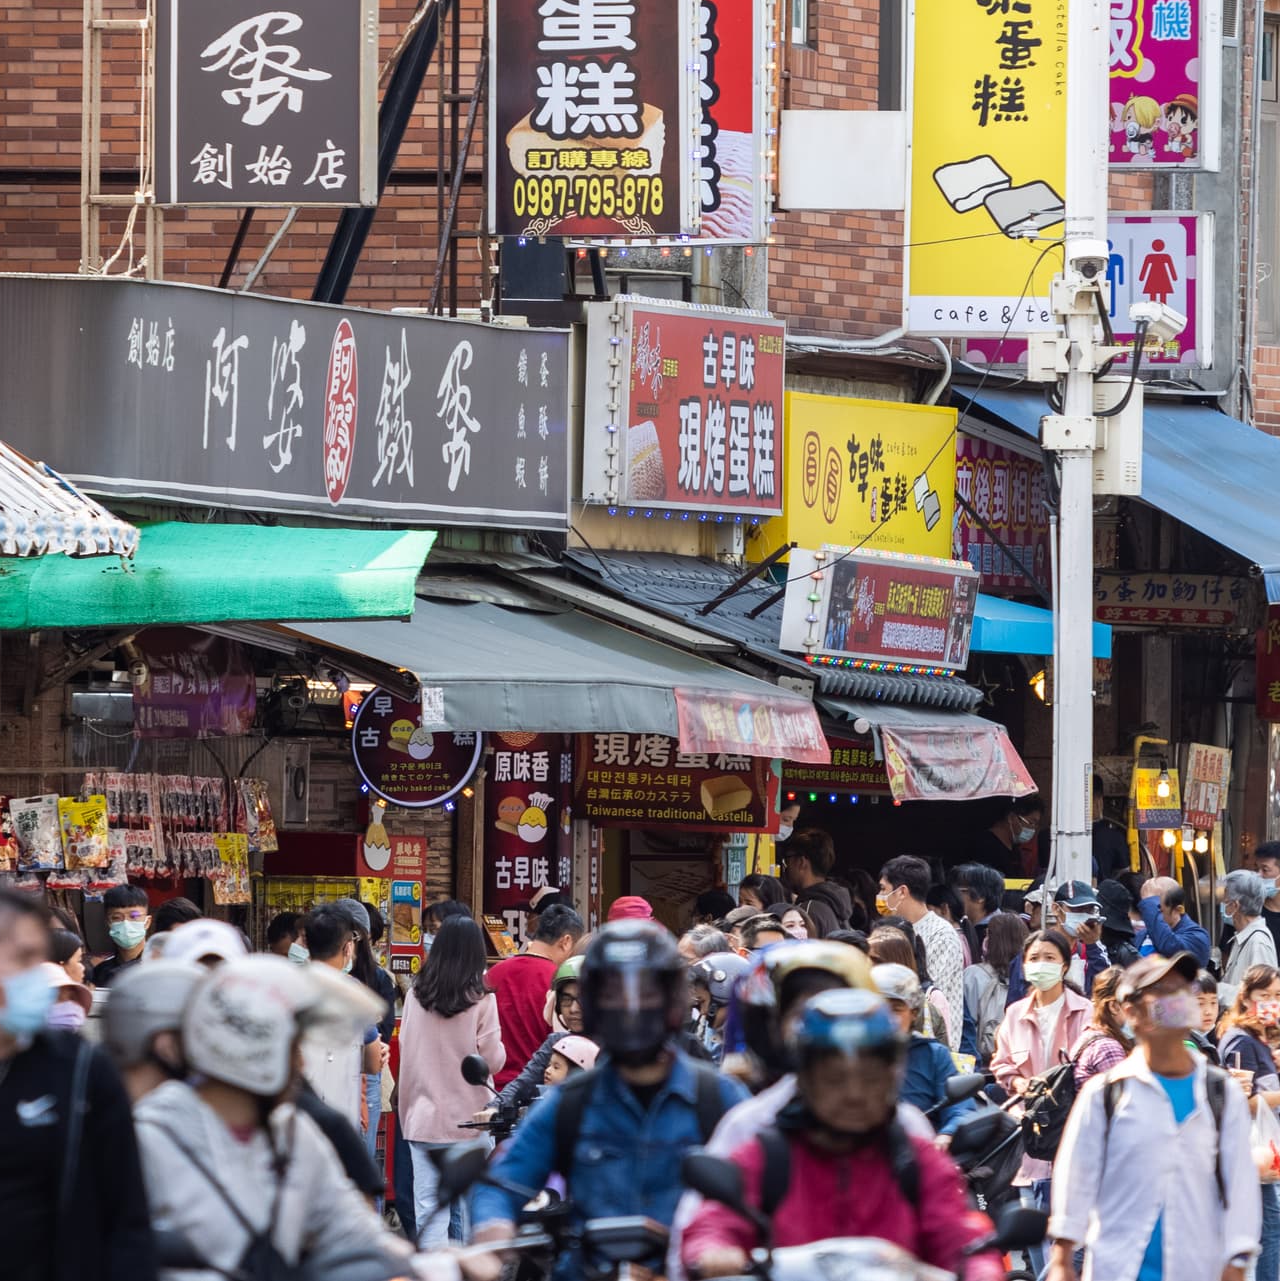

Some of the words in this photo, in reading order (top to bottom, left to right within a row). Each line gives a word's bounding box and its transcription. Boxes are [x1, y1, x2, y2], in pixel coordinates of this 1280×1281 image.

[190, 141, 349, 191] 創始店
[525, 150, 650, 171] 訂購專線
[513, 175, 664, 218] 0987-795-878
[933, 304, 994, 323] cafe
[1000, 305, 1014, 323] &
[1022, 304, 1050, 323] te
[126, 317, 176, 373] 創始店
[702, 331, 756, 391] 古早味
[677, 397, 777, 497] 現烤蛋糕
[495, 750, 550, 782] 原味香
[585, 803, 644, 818] Taiwanese
[647, 806, 706, 821] traditional
[710, 807, 754, 823] Castella
[495, 856, 550, 891] 古早味
